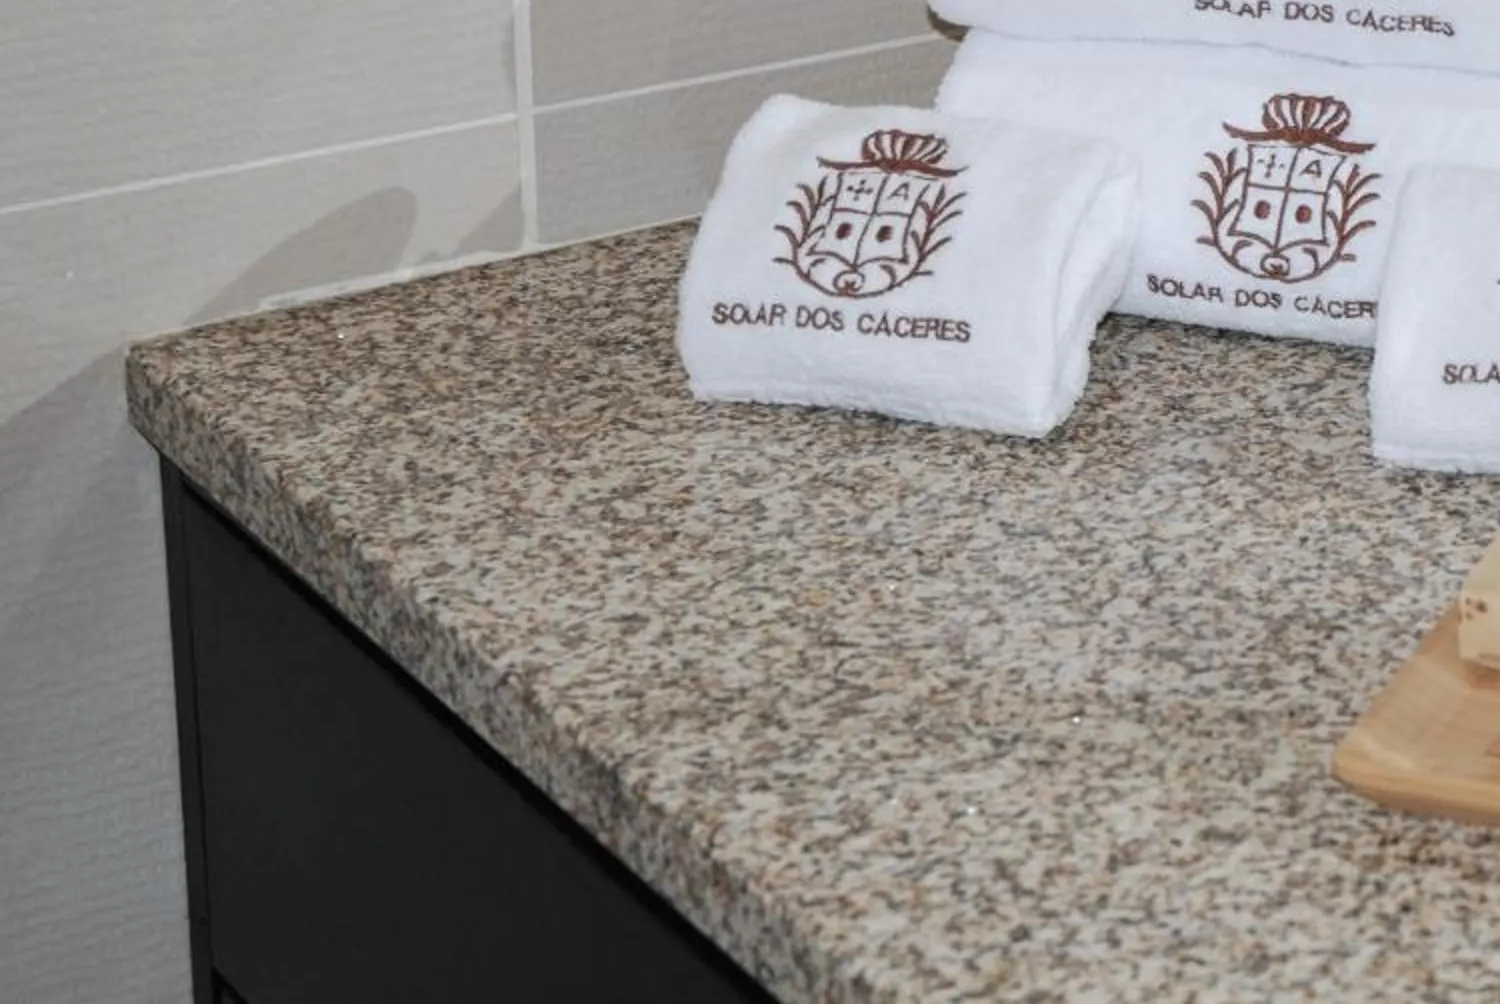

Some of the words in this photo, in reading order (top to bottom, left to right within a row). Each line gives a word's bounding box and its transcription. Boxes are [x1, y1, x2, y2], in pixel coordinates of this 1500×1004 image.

[1283, 0, 1334, 23] DOS
[1146, 273, 1224, 304] SOLAR
[1234, 288, 1283, 310] DOS
[711, 301, 787, 327] SOLAR
[794, 304, 845, 332] DOS
